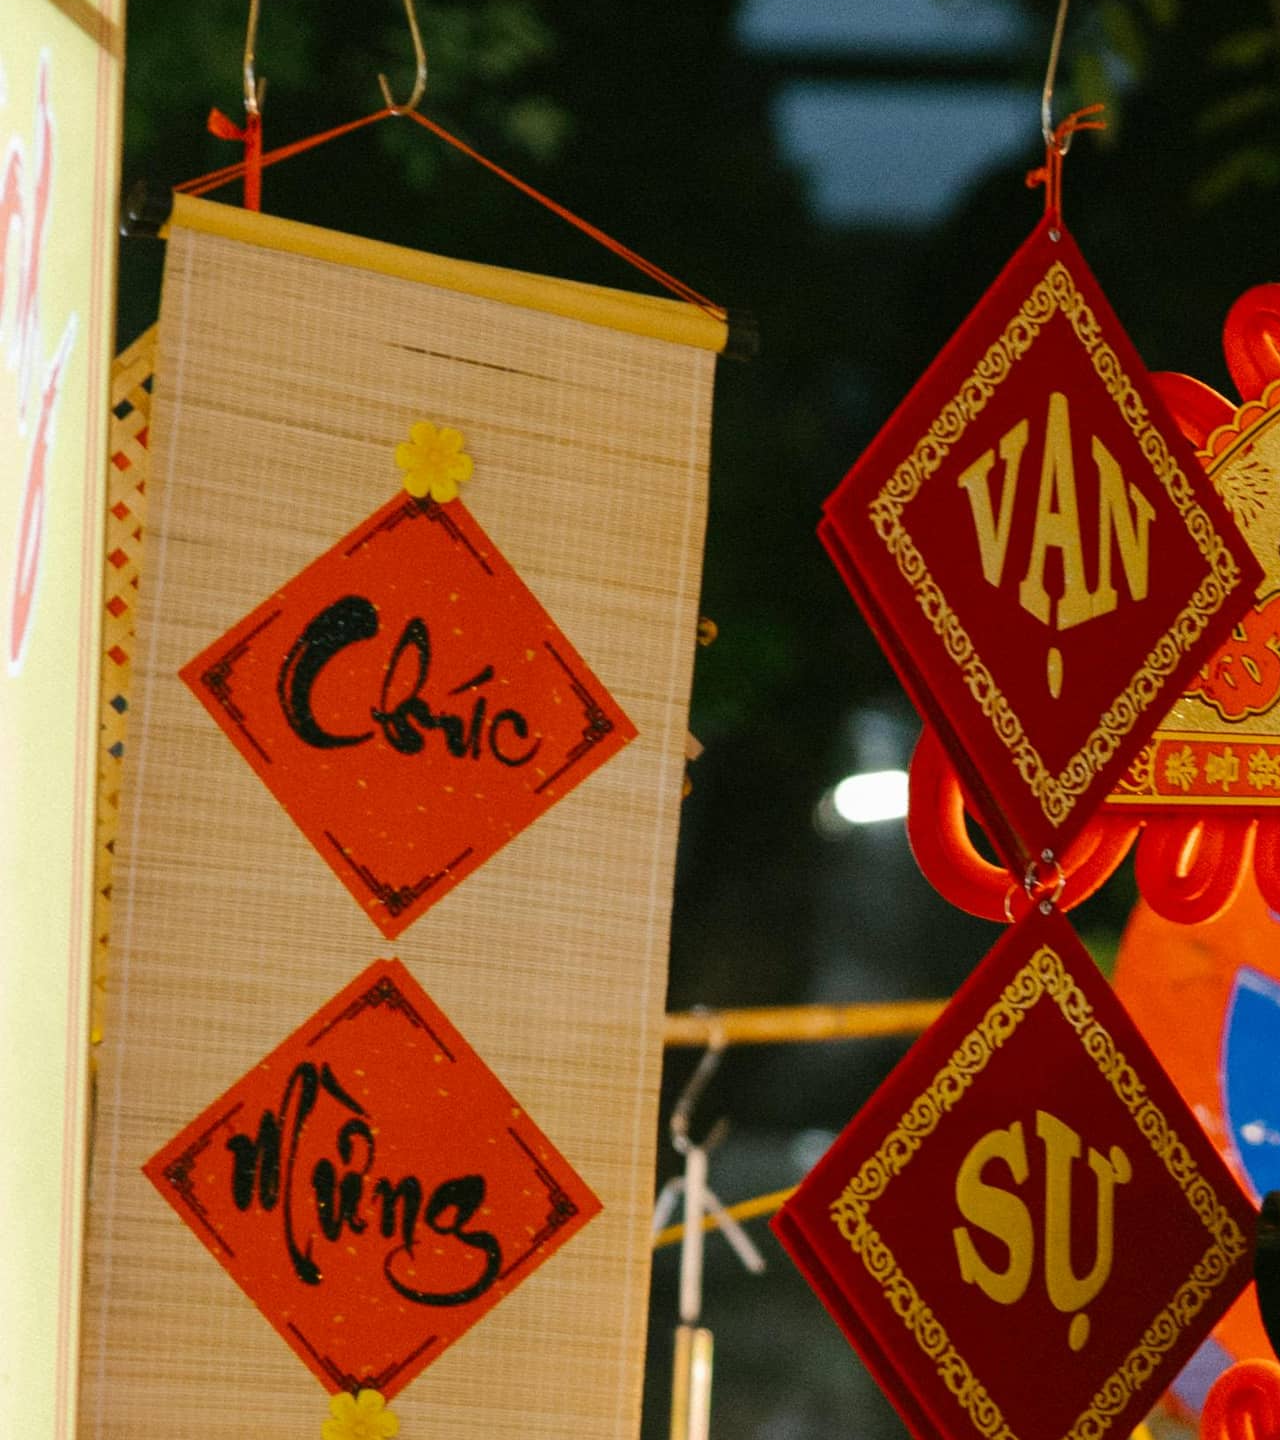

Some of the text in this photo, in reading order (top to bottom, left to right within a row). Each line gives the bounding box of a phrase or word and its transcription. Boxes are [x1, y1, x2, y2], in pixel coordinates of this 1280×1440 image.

[957, 391, 1157, 699] VẠN
[276, 594, 541, 768] Chúc
[226, 1061, 503, 1308] Mừng
[952, 1109, 1133, 1352] SỰ
